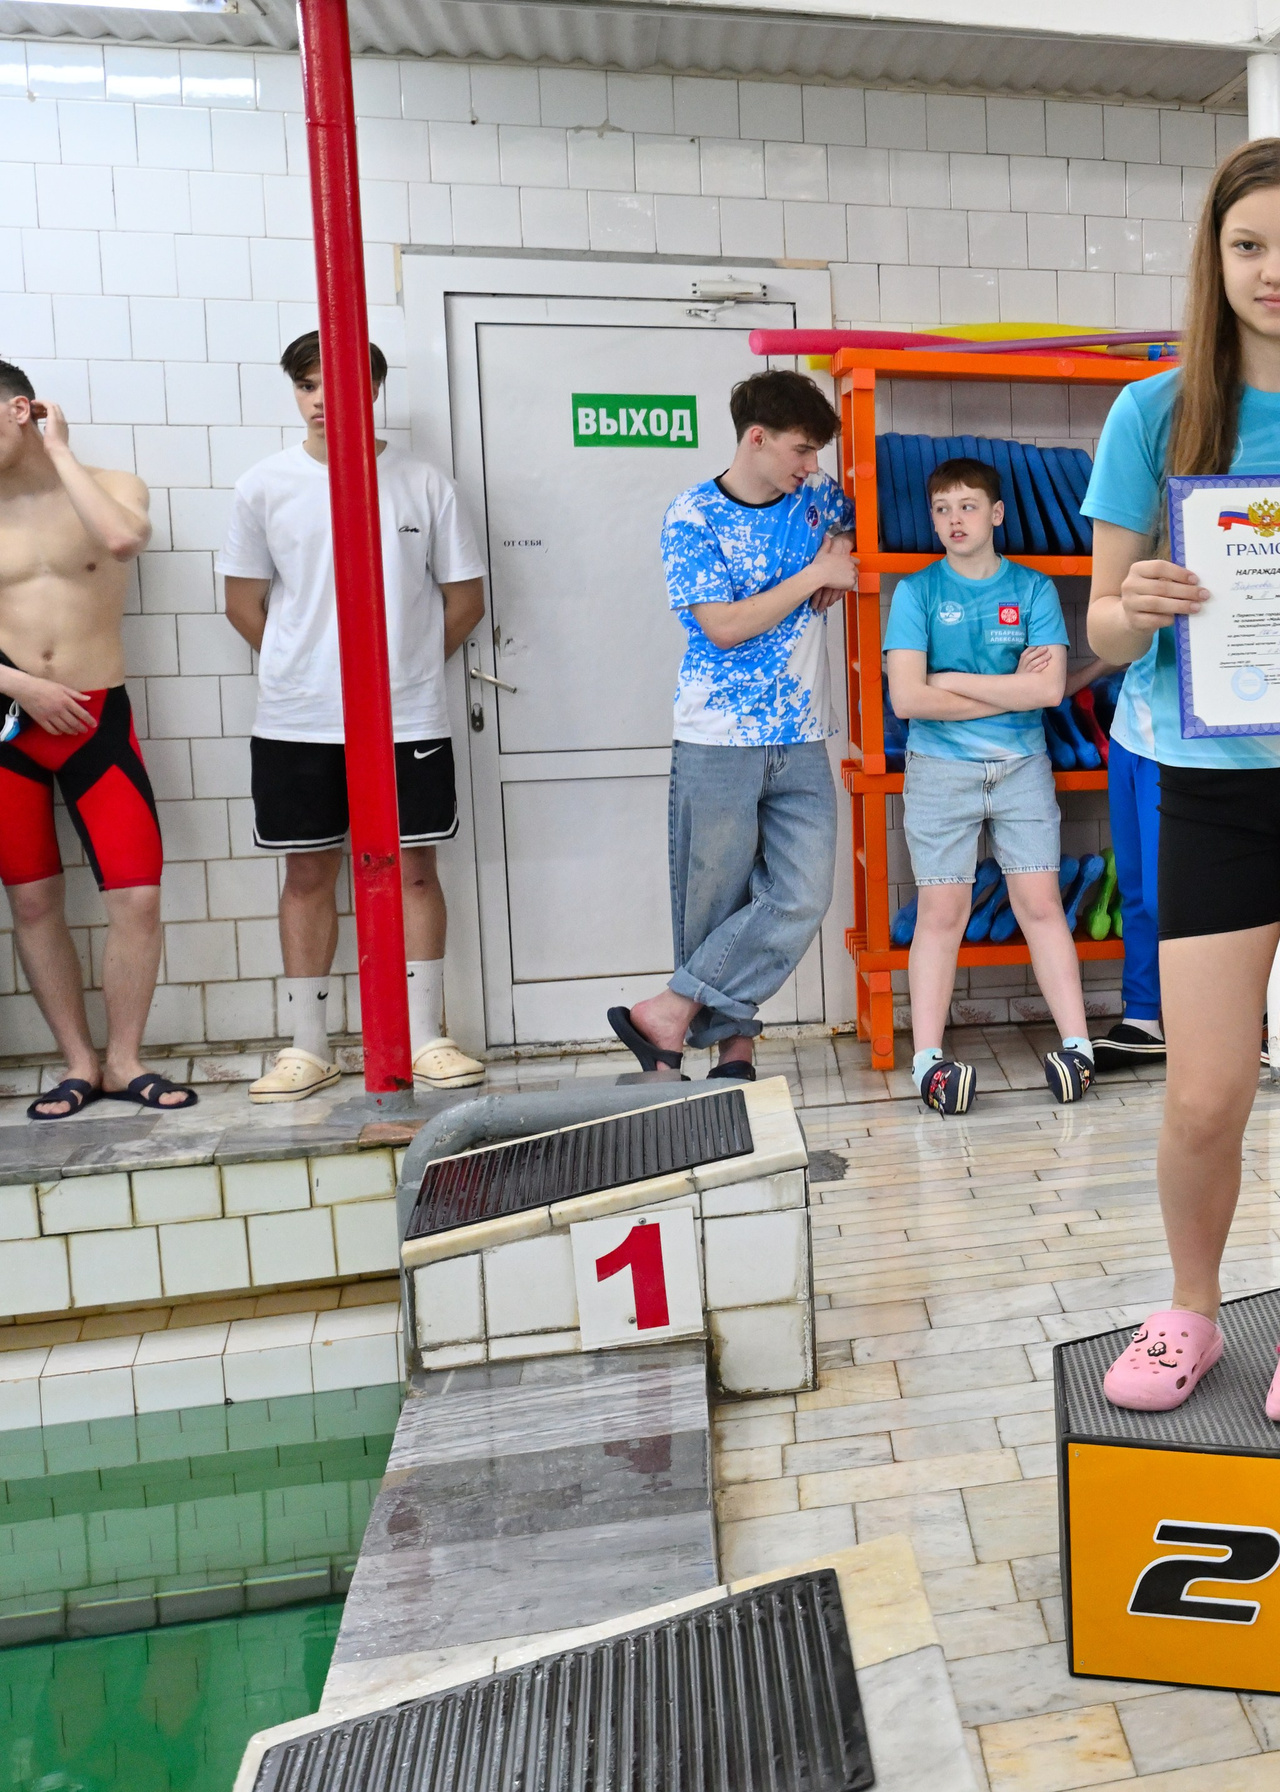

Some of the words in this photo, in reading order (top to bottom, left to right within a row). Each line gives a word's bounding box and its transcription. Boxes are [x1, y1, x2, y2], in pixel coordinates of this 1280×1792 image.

[577, 407, 693, 442] ВЫХОД
[503, 540, 516, 548] ОТ
[518, 539, 542, 547] СЕБЯ
[595, 1222, 670, 1331] 1
